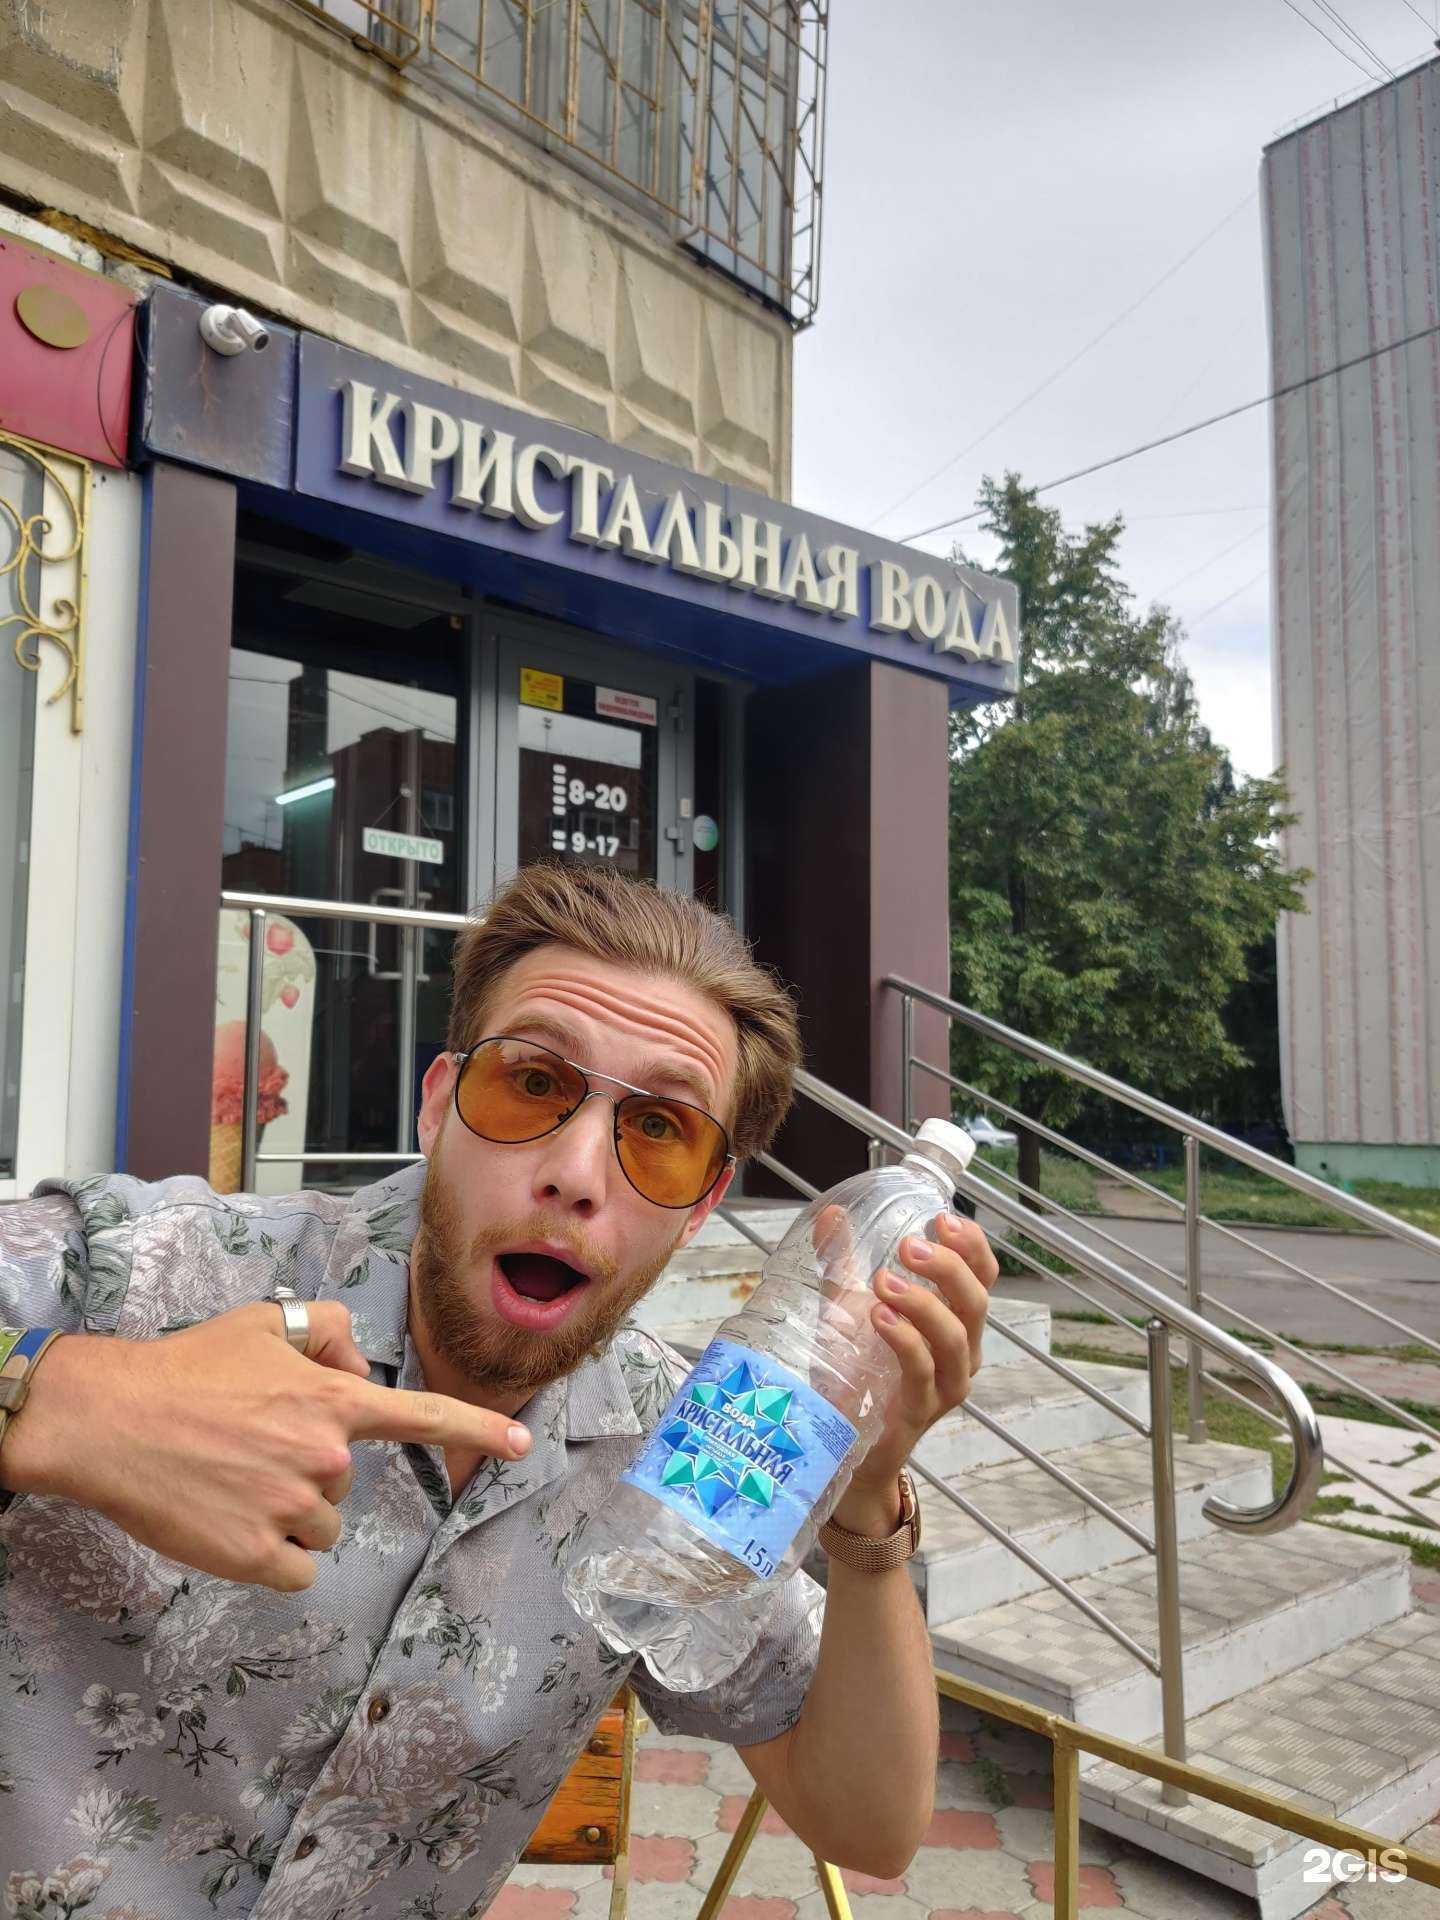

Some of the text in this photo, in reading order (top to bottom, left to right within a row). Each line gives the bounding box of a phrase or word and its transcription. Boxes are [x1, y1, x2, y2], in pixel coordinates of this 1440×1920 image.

[341, 380, 1014, 664] КРИСТАЛЬНАЯ ВОДА
[568, 778, 628, 813] 8-20
[367, 832, 440, 861] ОТКРЫТО
[571, 831, 620, 858] 9-17
[721, 1402, 757, 1430] ВОДА
[674, 1399, 794, 1486] КРИСТАЛЬНАЯ
